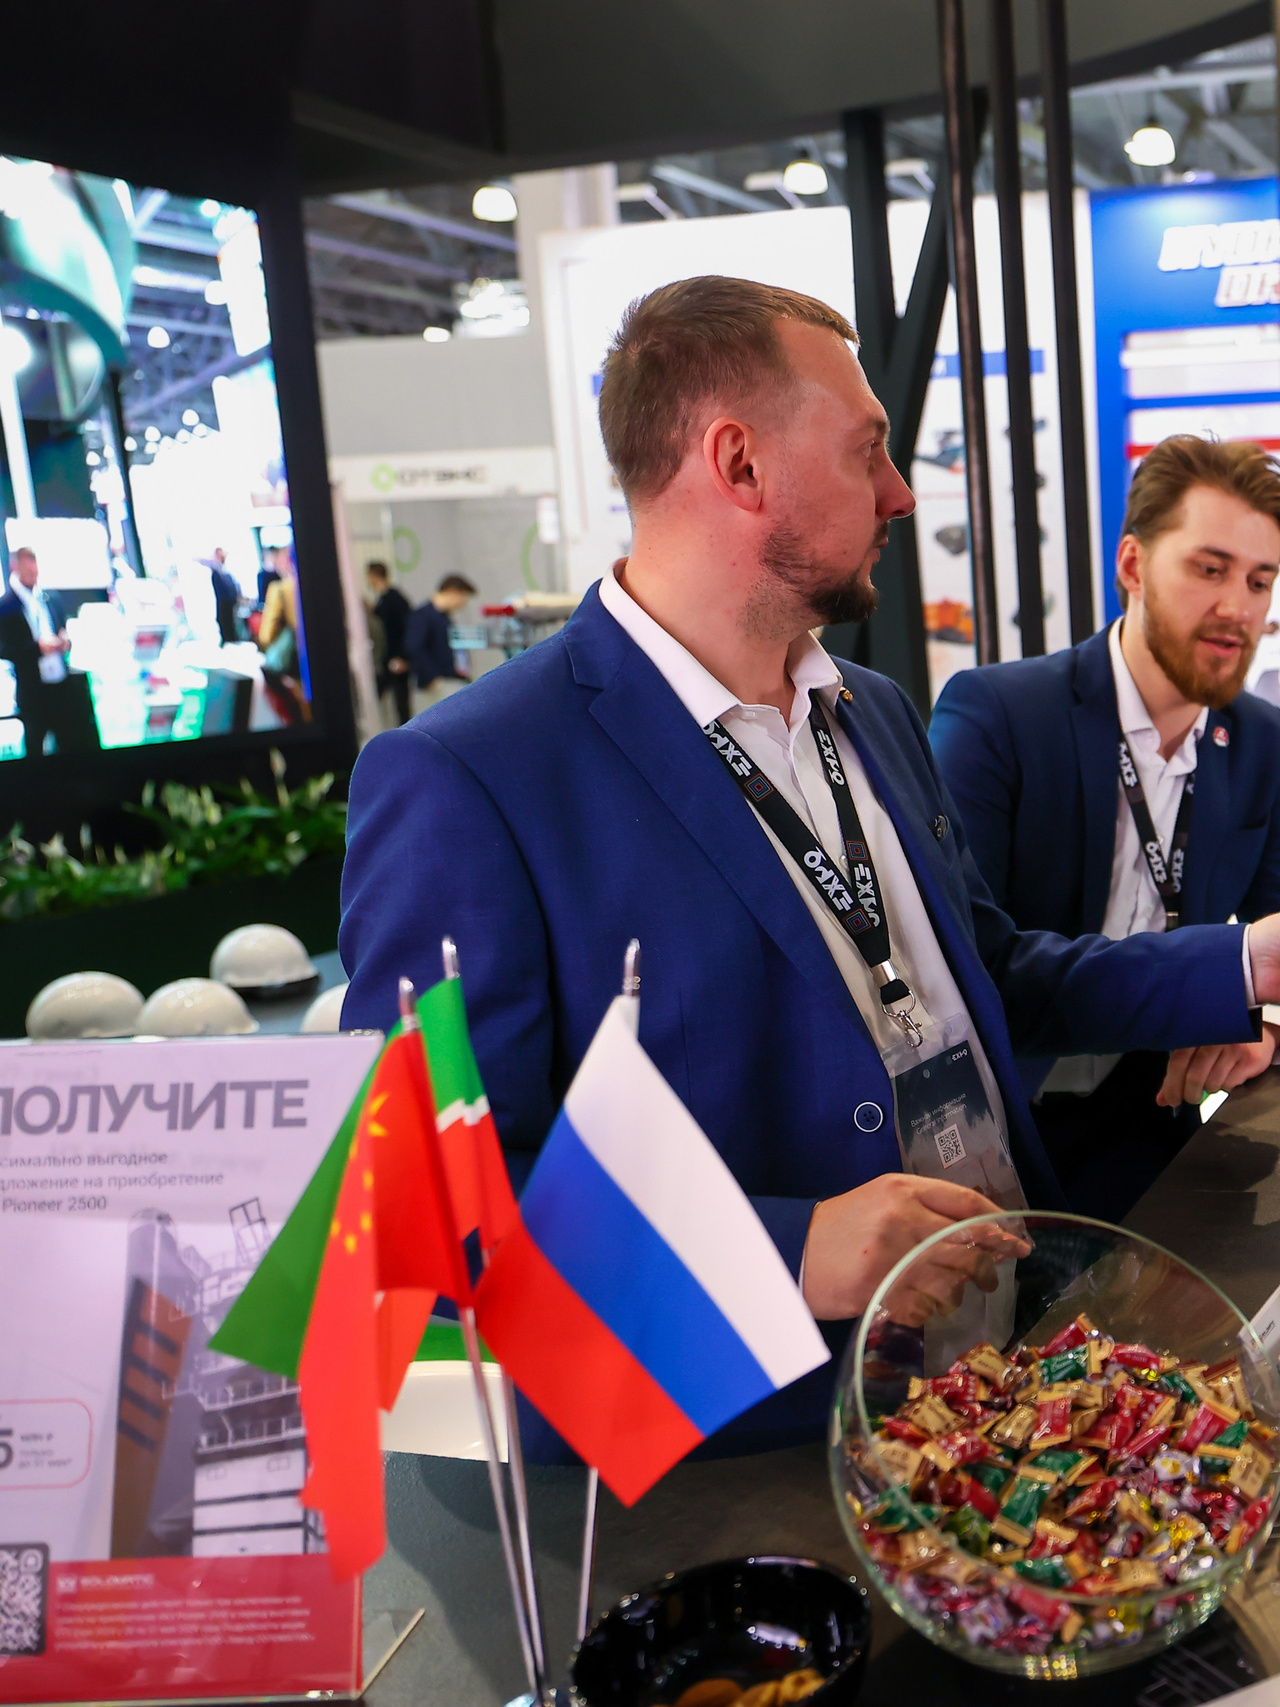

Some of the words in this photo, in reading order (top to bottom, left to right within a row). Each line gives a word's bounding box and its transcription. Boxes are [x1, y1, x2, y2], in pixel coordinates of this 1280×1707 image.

[818, 729, 845, 785] EXPO
[804, 845, 853, 911] EXPO
[87, 1152, 168, 1168] выгодное
[84, 1176, 103, 1189] на
[108, 1171, 224, 1191] приобретение
[2, 1198, 62, 1213] Pioneer
[68, 1195, 107, 1211] 2500
